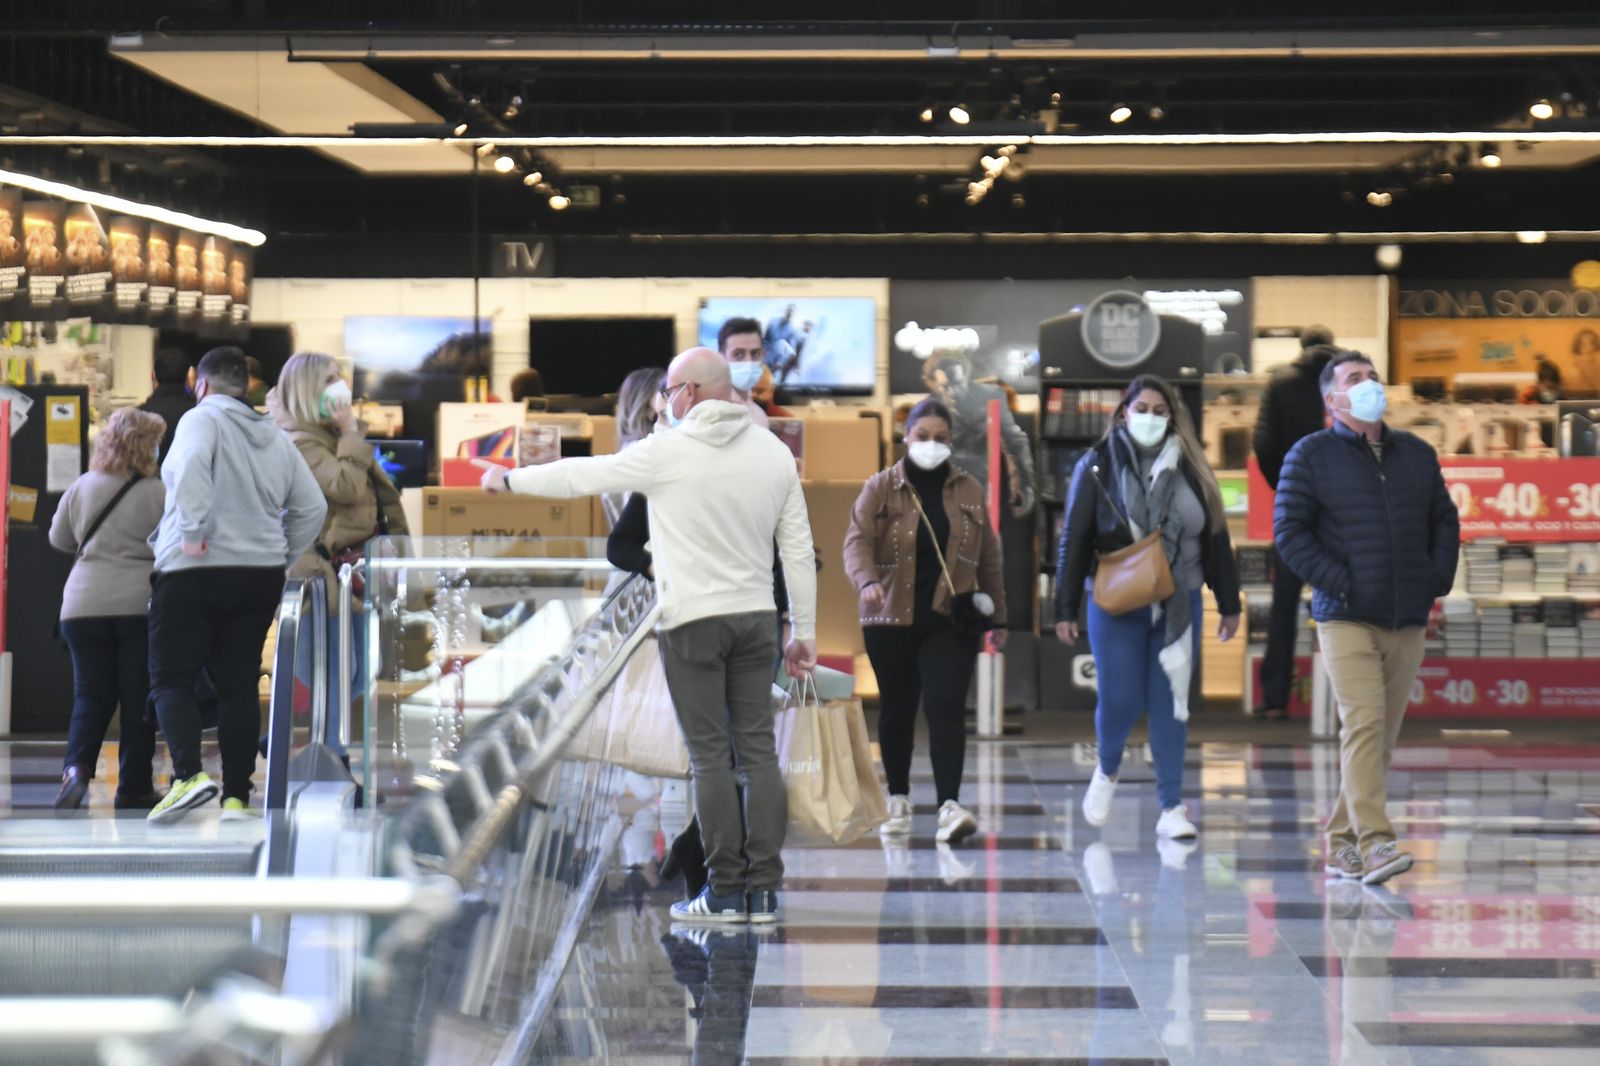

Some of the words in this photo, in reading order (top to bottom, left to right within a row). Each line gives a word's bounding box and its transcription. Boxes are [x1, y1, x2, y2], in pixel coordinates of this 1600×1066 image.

[501, 242, 544, 271] TV
[1101, 303, 1140, 327] DC
[1398, 289, 1487, 317] ZONA
